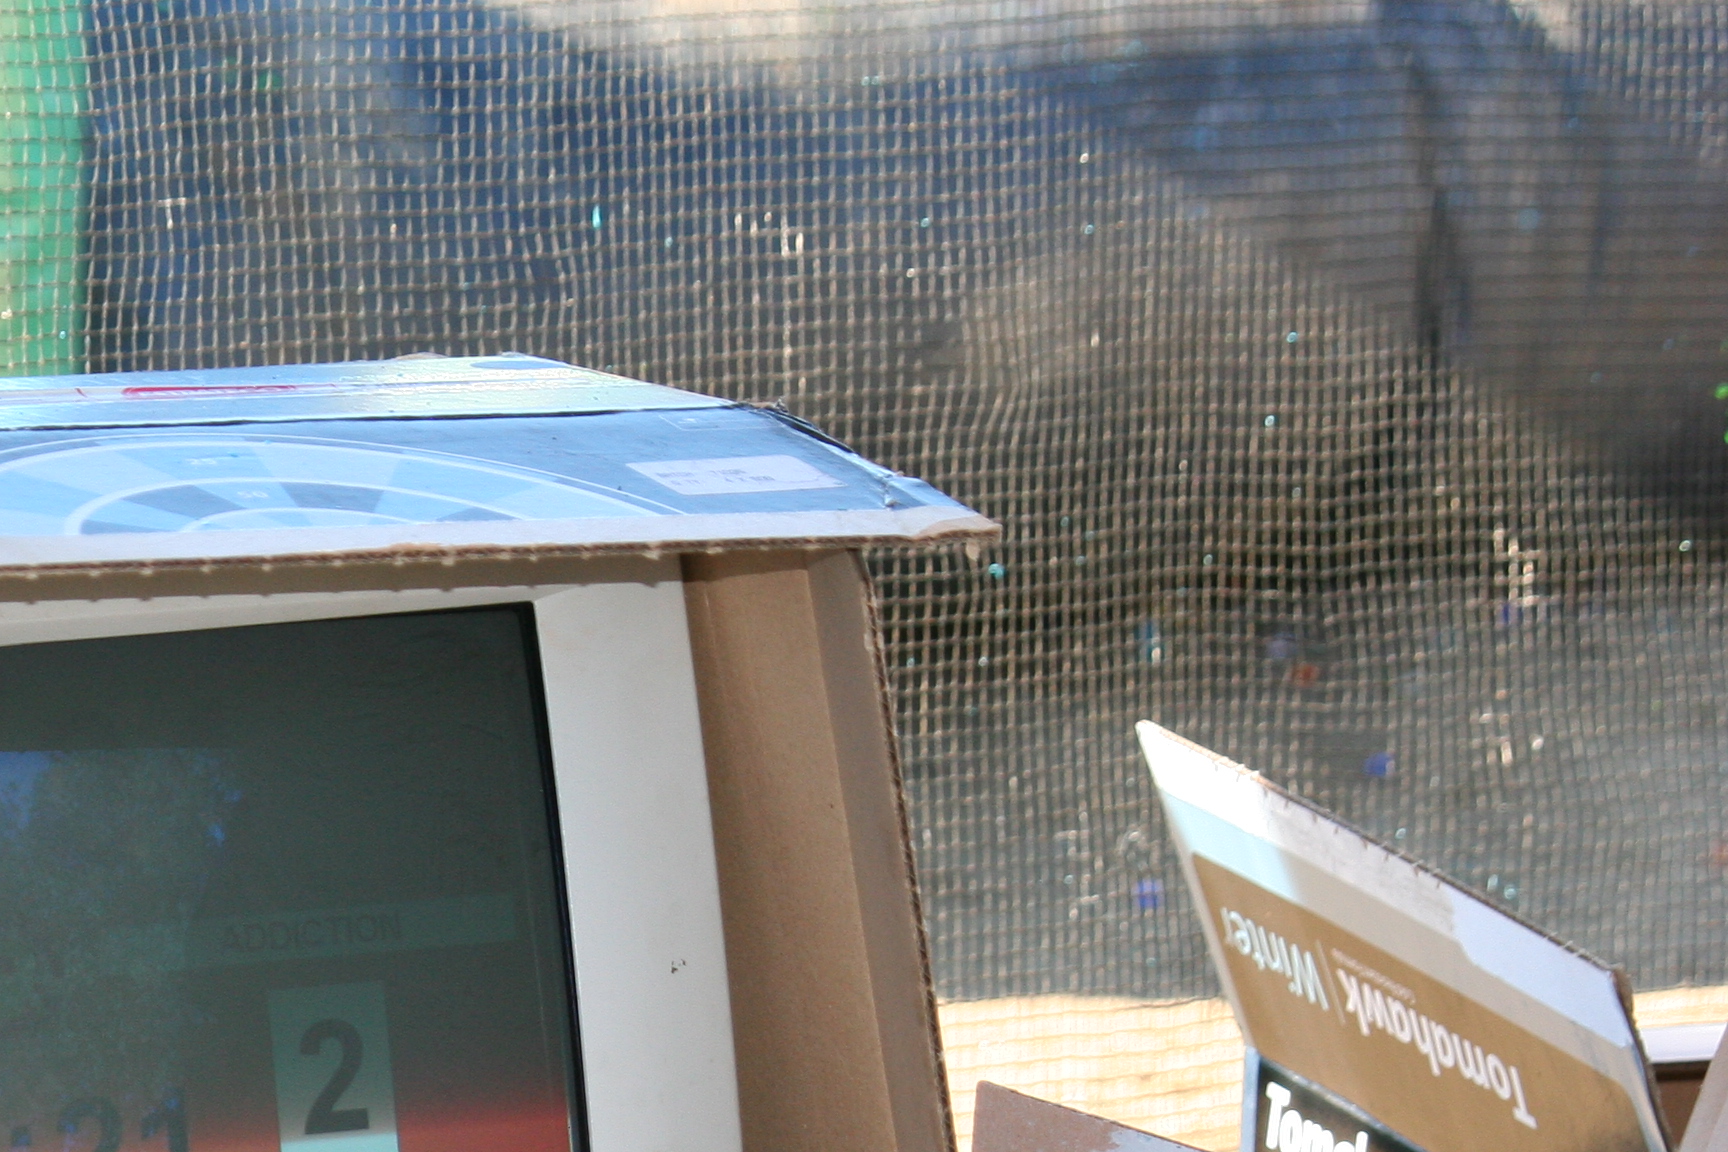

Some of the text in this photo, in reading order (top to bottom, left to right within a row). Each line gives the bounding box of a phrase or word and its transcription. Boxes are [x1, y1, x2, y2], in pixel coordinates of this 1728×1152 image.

[223, 912, 403, 949] ADDICTION
[299, 1017, 370, 1136] 2
[1221, 906, 1330, 1012] Winter
[1337, 968, 1538, 1130] Tomahawk
